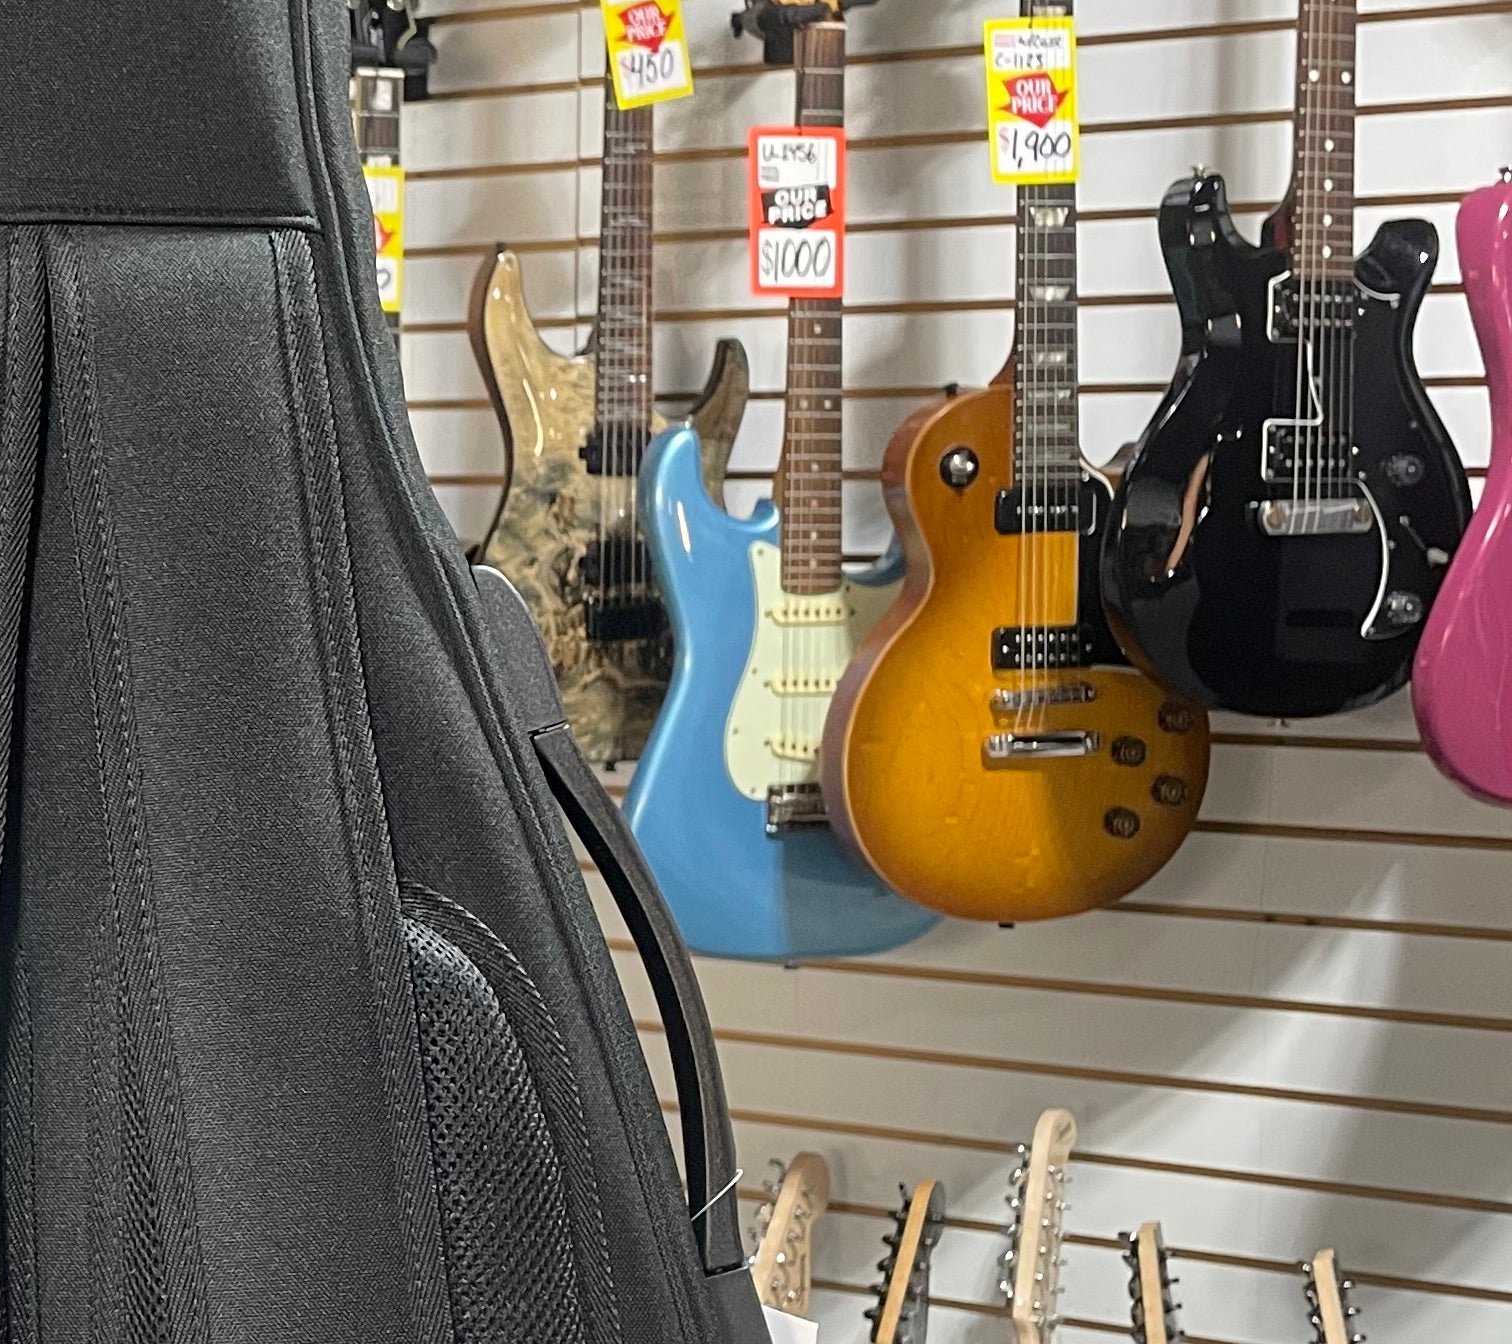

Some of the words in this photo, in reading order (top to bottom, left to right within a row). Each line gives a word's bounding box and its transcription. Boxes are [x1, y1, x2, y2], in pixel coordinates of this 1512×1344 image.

[1016, 79, 1052, 98] OUR
[1010, 94, 1059, 114] PRICE
[774, 186, 818, 206] OUR
[767, 199, 828, 225] PRICE
[760, 236, 833, 284] $1000
